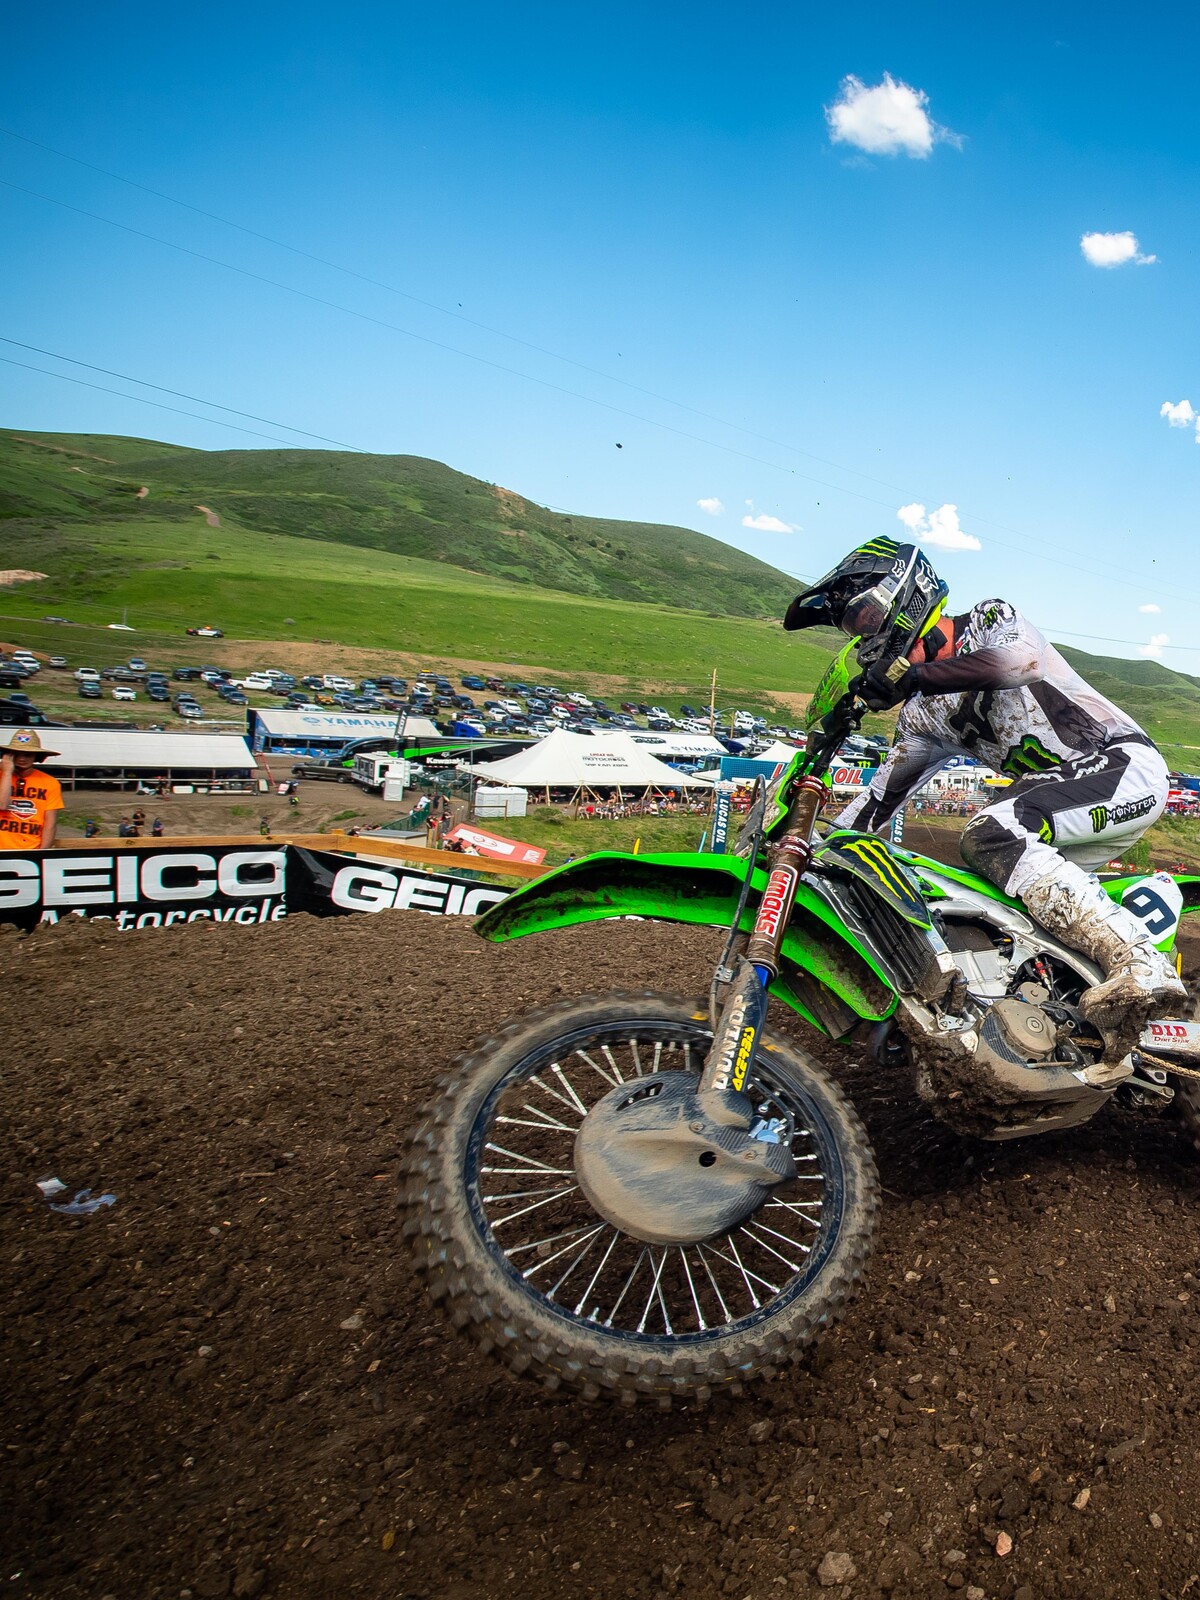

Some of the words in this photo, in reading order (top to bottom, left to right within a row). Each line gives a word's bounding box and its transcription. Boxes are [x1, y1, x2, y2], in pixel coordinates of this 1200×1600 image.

[323, 717, 398, 729] YAMAHA
[834, 767, 863, 785] OIL
[718, 798, 729, 828] LUCAS
[1107, 796, 1155, 820] MONSTER
[0, 820, 41, 835] CREW
[715, 828, 727, 844] OIL
[331, 866, 511, 915] GEIC
[755, 870, 792, 938] SHOWA
[1122, 886, 1177, 936] 9
[711, 994, 747, 1090] DUNLOP
[732, 1026, 756, 1092] ACERBIS
